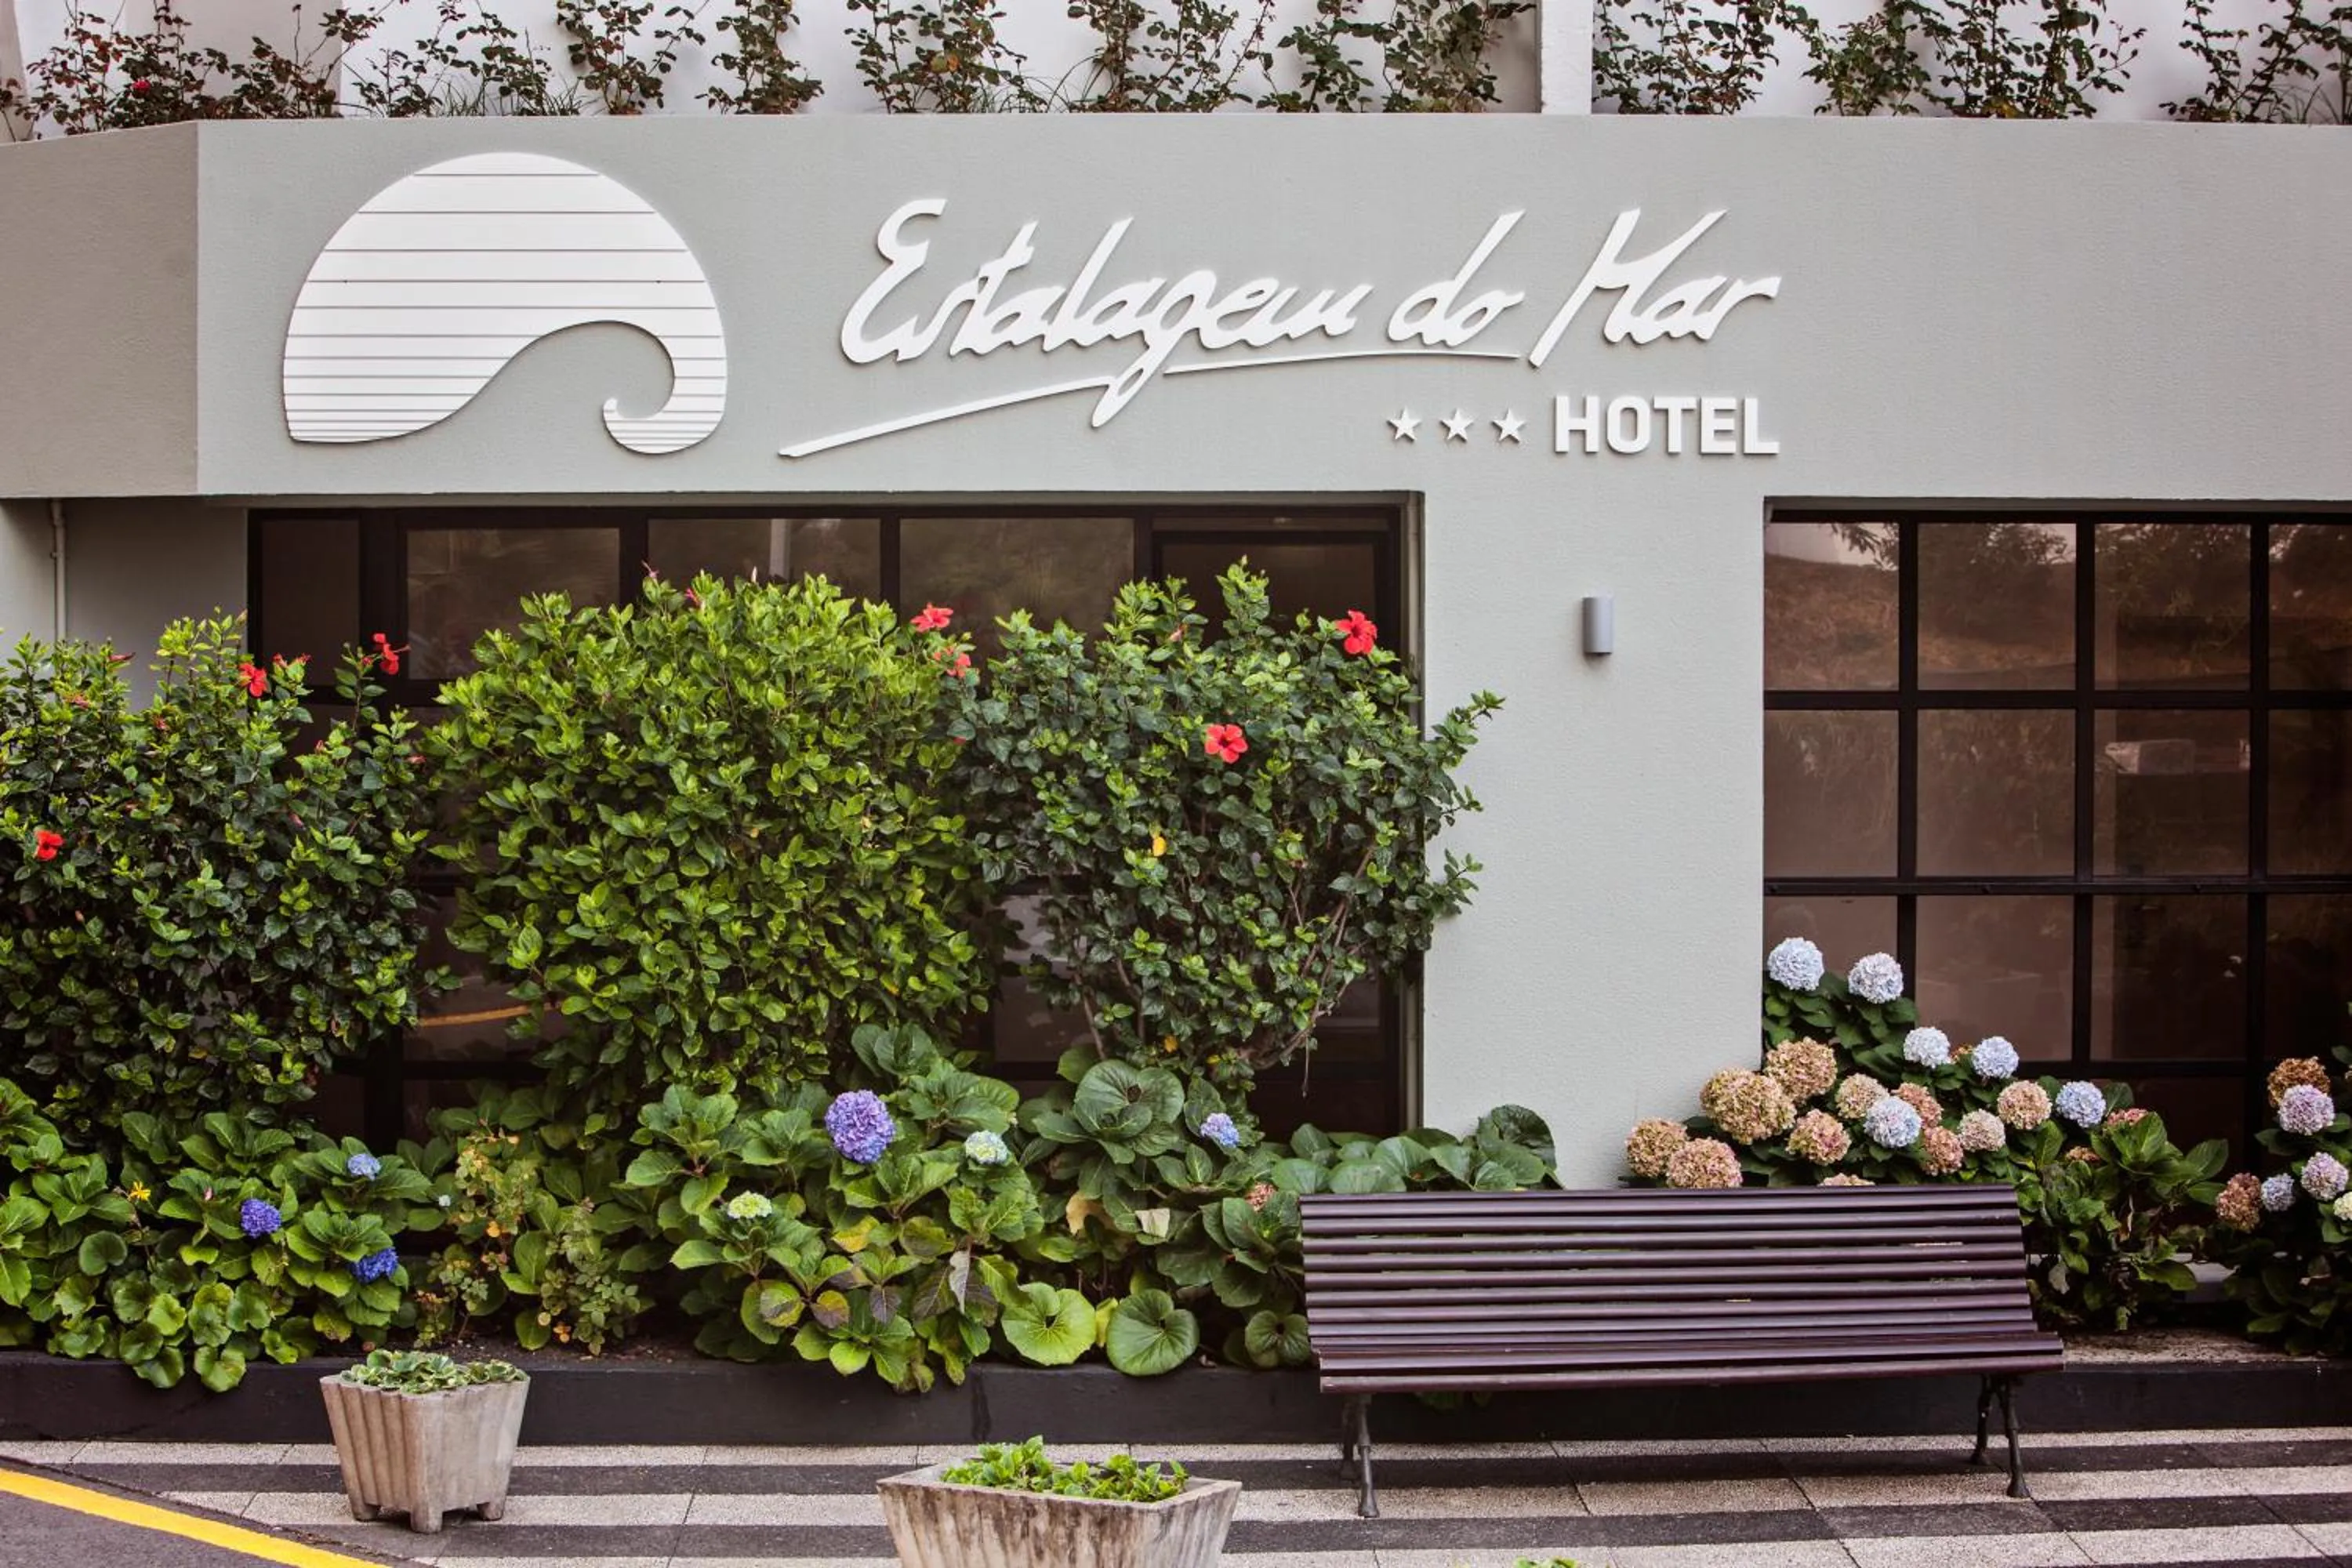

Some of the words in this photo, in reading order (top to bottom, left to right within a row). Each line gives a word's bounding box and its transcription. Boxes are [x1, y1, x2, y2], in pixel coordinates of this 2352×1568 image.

[840, 197, 1374, 428] Estalagem
[1387, 209, 1526, 347] do
[1528, 208, 1782, 368] Mar
[1554, 394, 1781, 455] HOTEL
